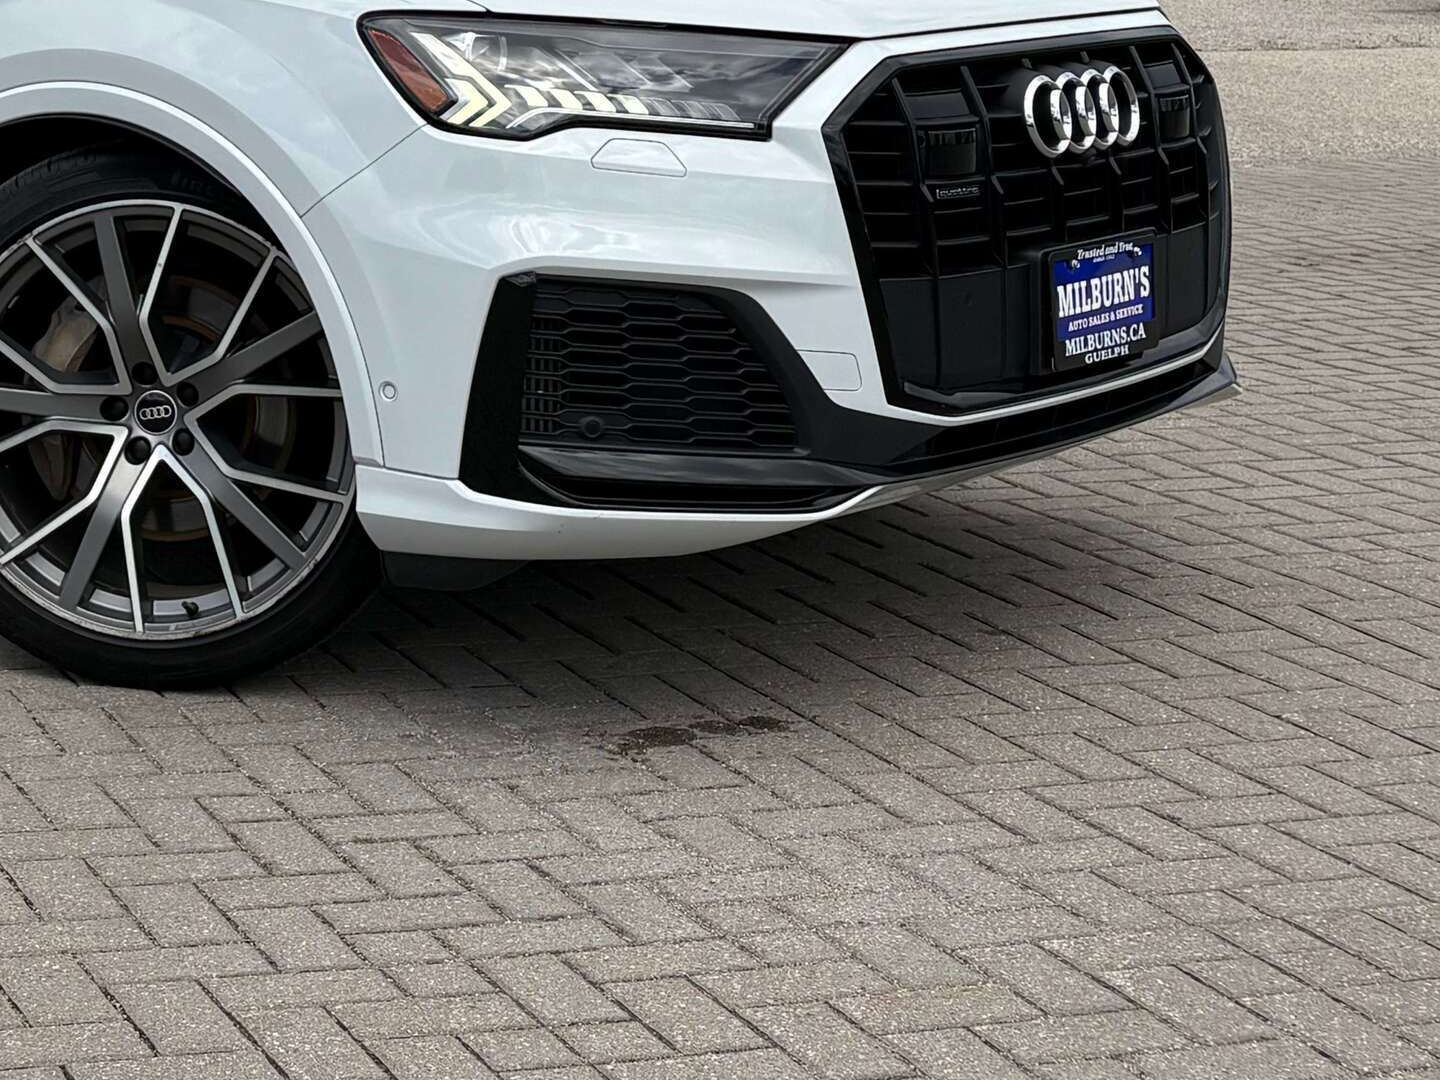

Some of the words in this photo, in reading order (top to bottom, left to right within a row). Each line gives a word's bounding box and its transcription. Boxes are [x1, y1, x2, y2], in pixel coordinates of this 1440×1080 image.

[1056, 265, 1150, 318] MILBURN'S
[1068, 318, 1088, 332] AUTO
[1088, 313, 1110, 327] SALES
[1116, 304, 1144, 320] SERVICE
[1065, 322, 1147, 357] MILBURNS.CA
[1085, 345, 1129, 365] GUELPH
